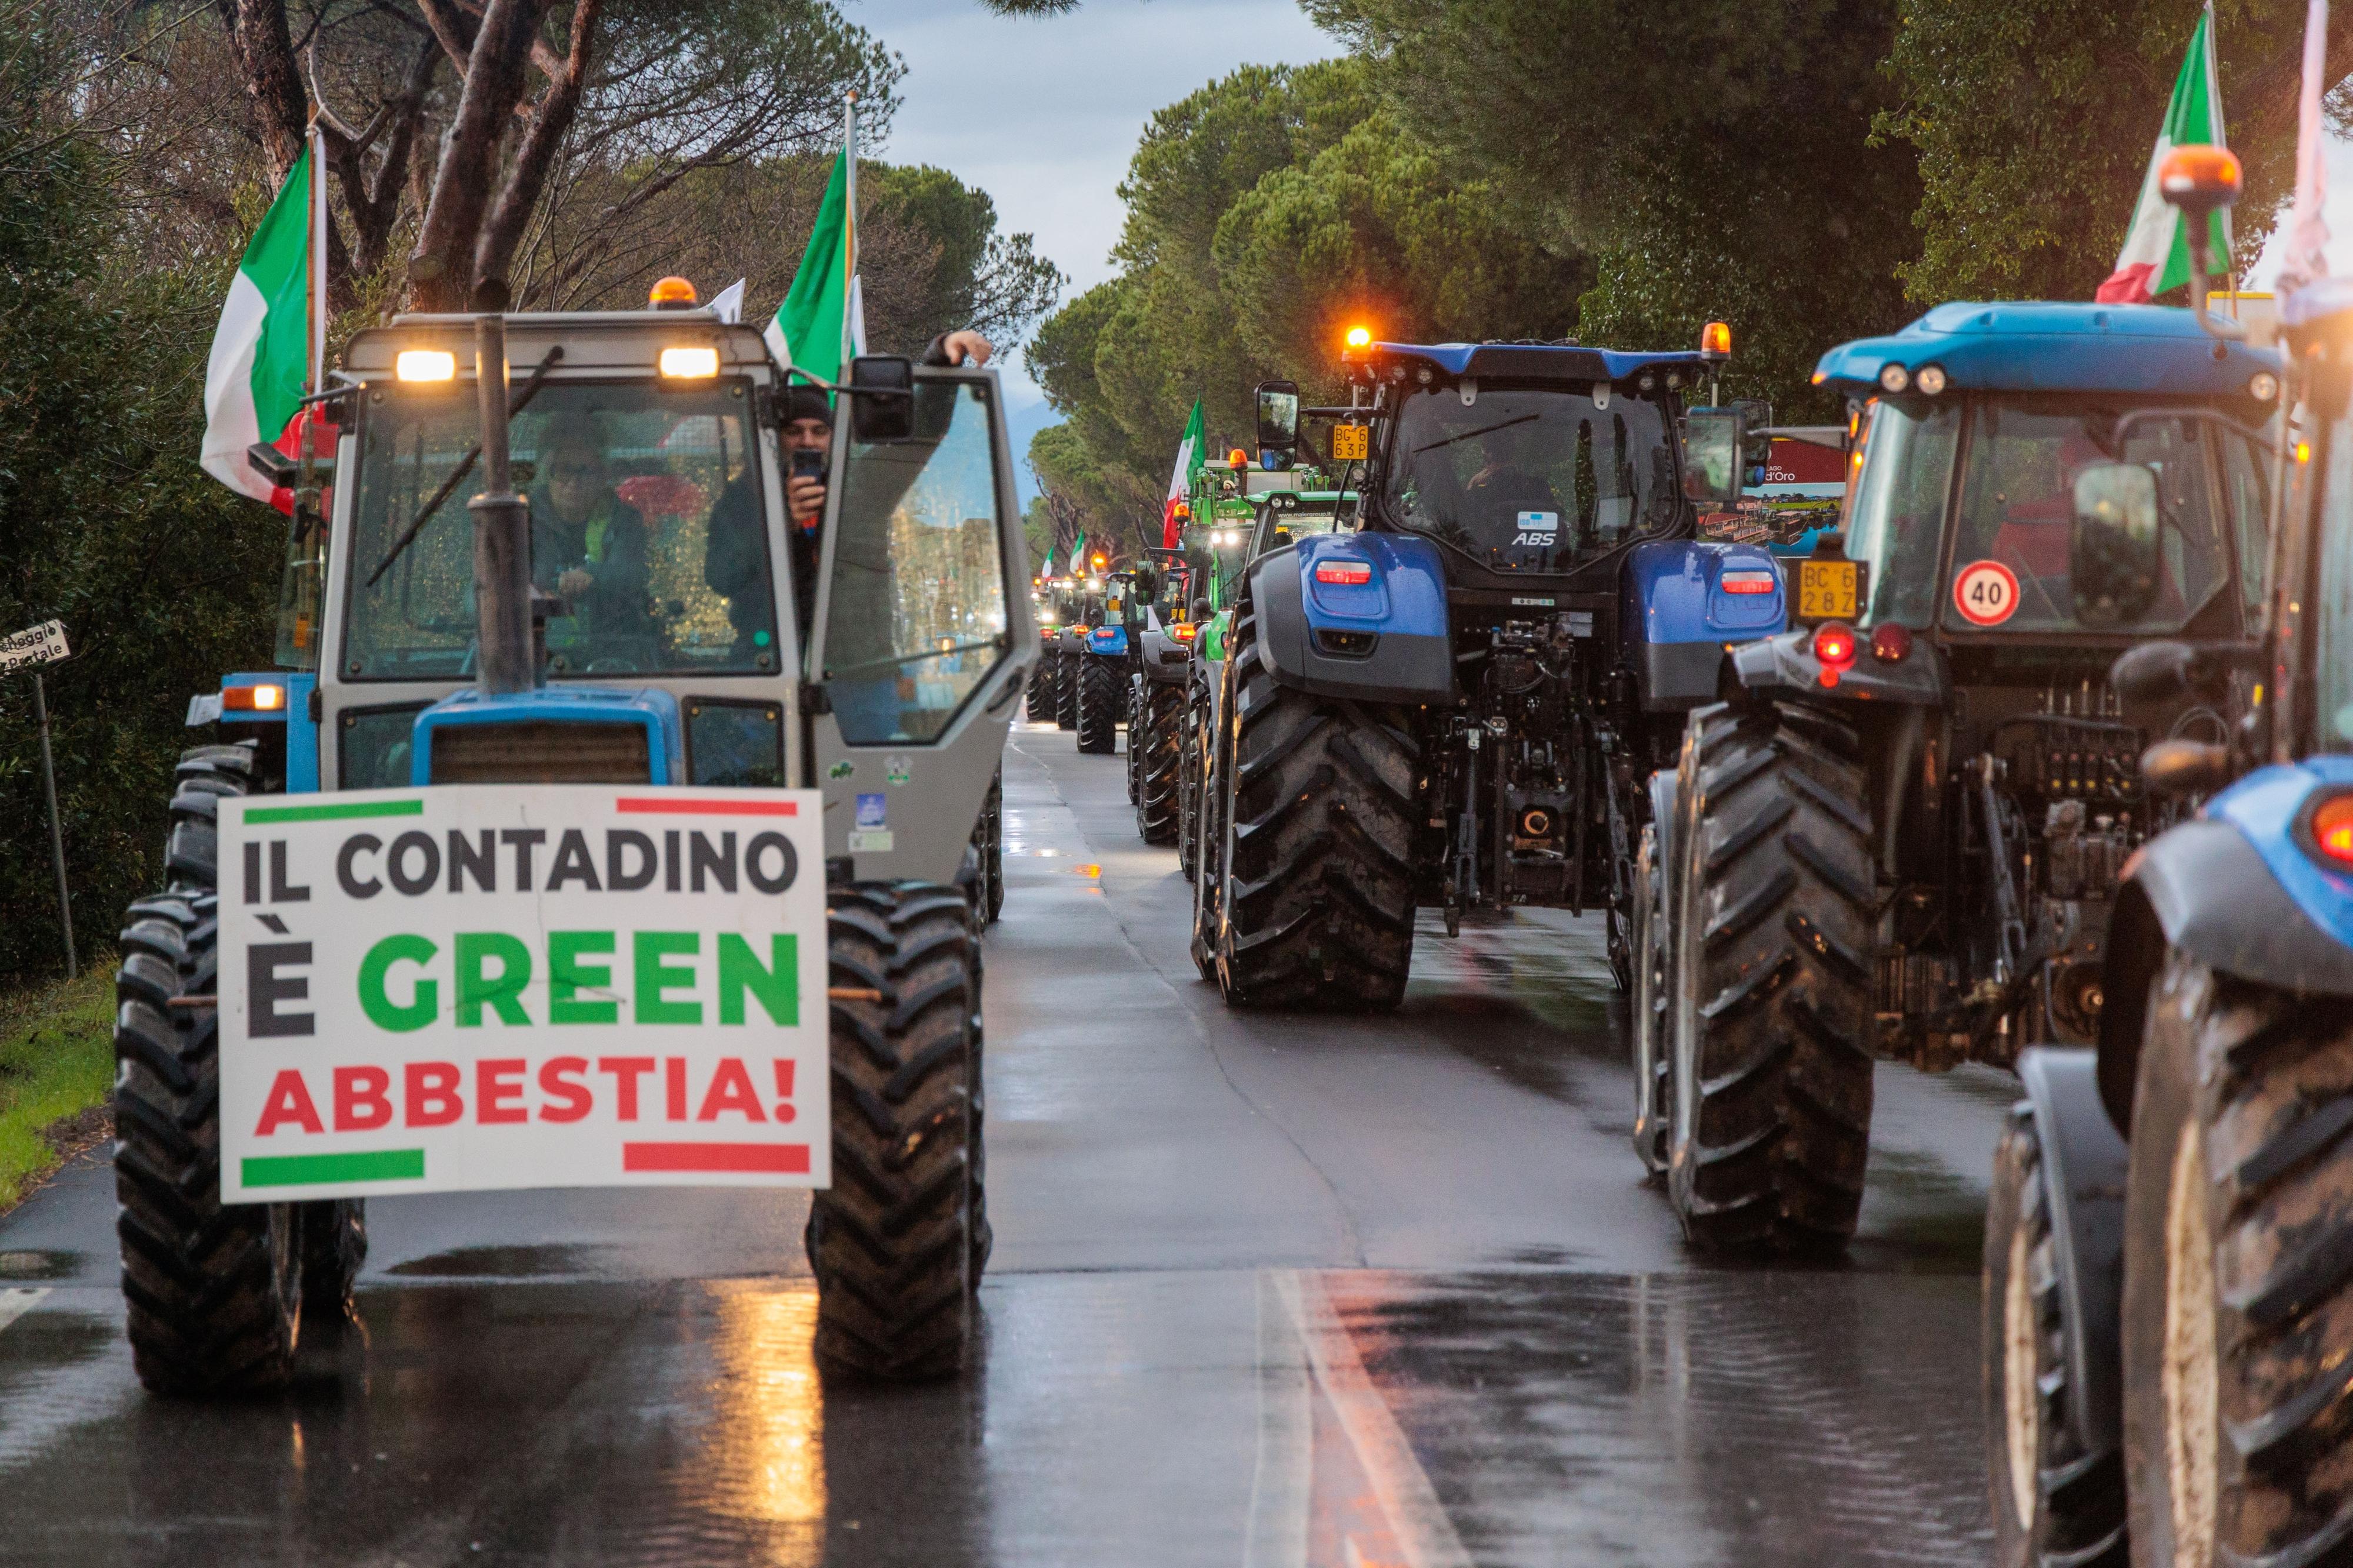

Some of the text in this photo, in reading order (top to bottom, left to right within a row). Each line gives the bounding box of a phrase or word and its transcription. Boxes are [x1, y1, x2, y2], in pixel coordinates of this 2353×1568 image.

[1336, 428, 1367, 441] BG 6
[1512, 532, 1557, 546] ABS
[1805, 566, 1828, 588] BC
[1972, 581, 2002, 605] 40
[244, 829, 799, 904] IL CONTADINO
[247, 915, 800, 1039] È GREEN
[254, 1056, 798, 1136] ABBESTIA!
